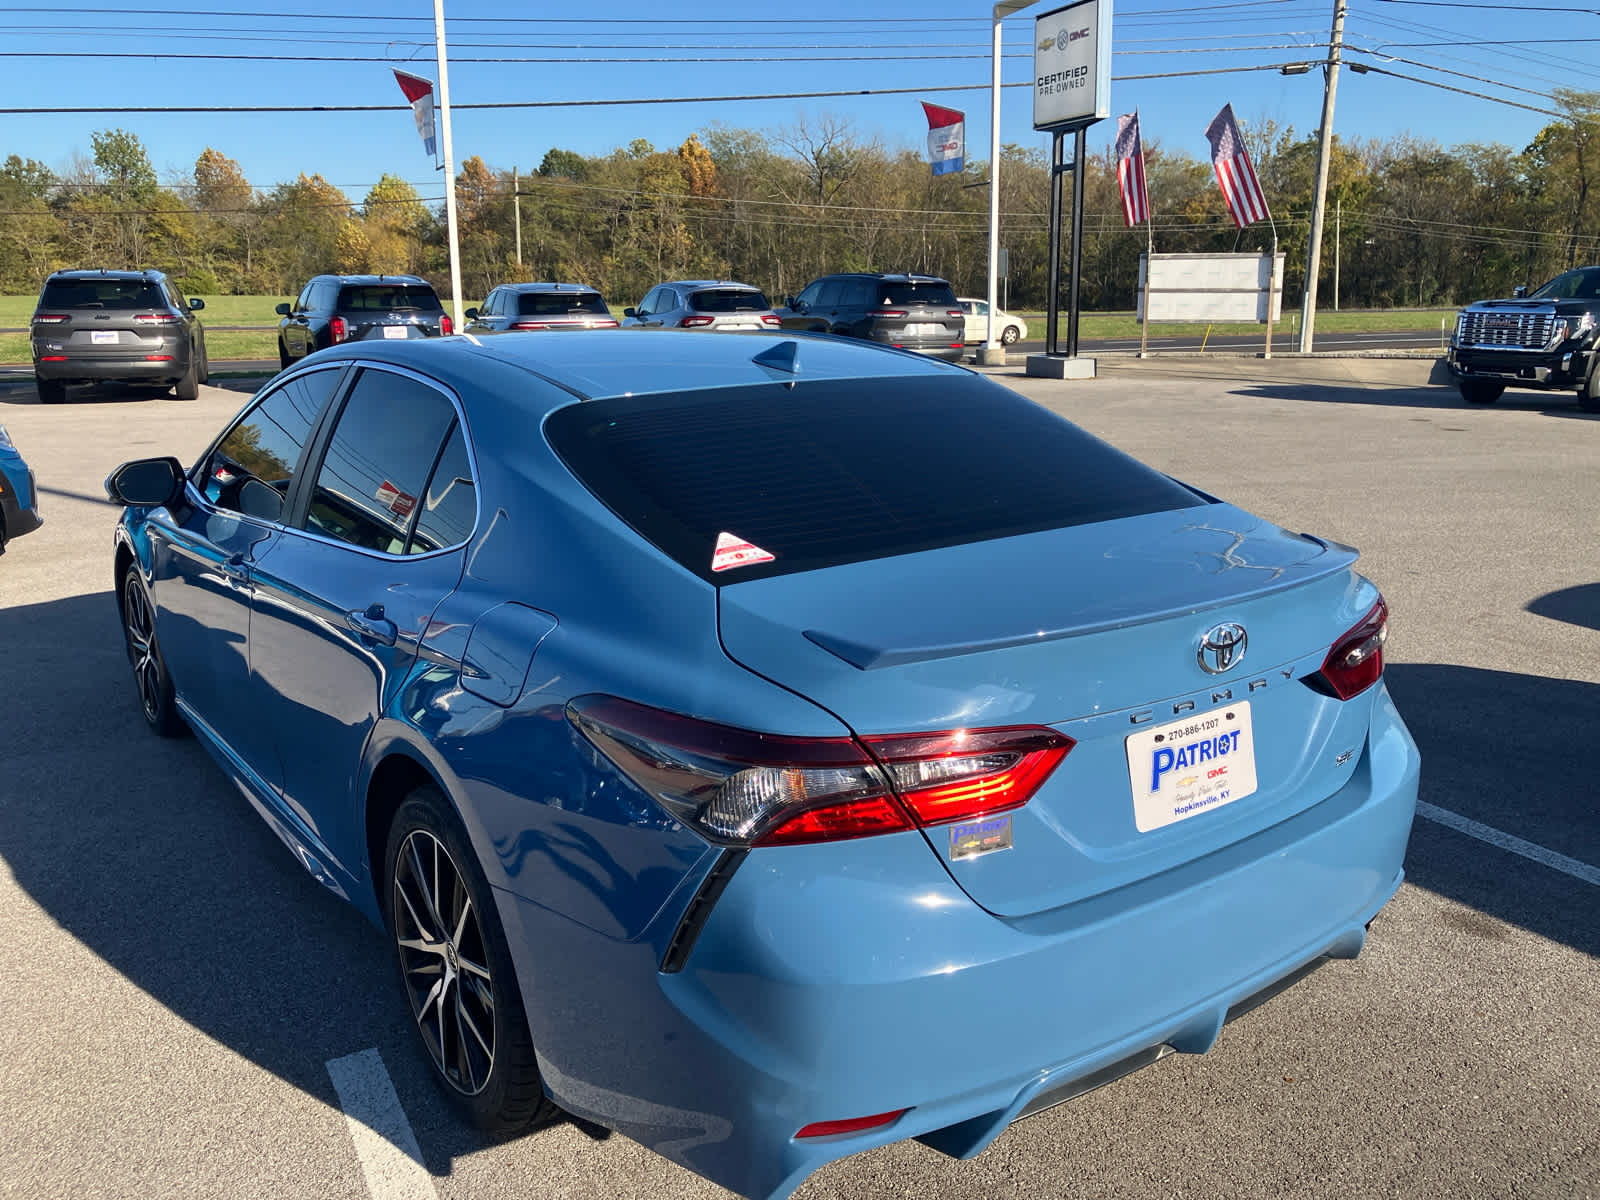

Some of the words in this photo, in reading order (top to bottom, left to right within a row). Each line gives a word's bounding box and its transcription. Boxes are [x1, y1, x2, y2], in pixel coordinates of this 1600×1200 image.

[1069, 27, 1090, 41] GMC
[1037, 65, 1088, 88] CERTIFIED
[1130, 666, 1295, 724] CAMRY
[1168, 718, 1220, 741] 270-886-1207
[1150, 729, 1241, 794] PATRIOT
[1207, 766, 1229, 779] GMC
[1174, 793, 1220, 816] Hopkinsville,
[1220, 789, 1230, 799] KY
